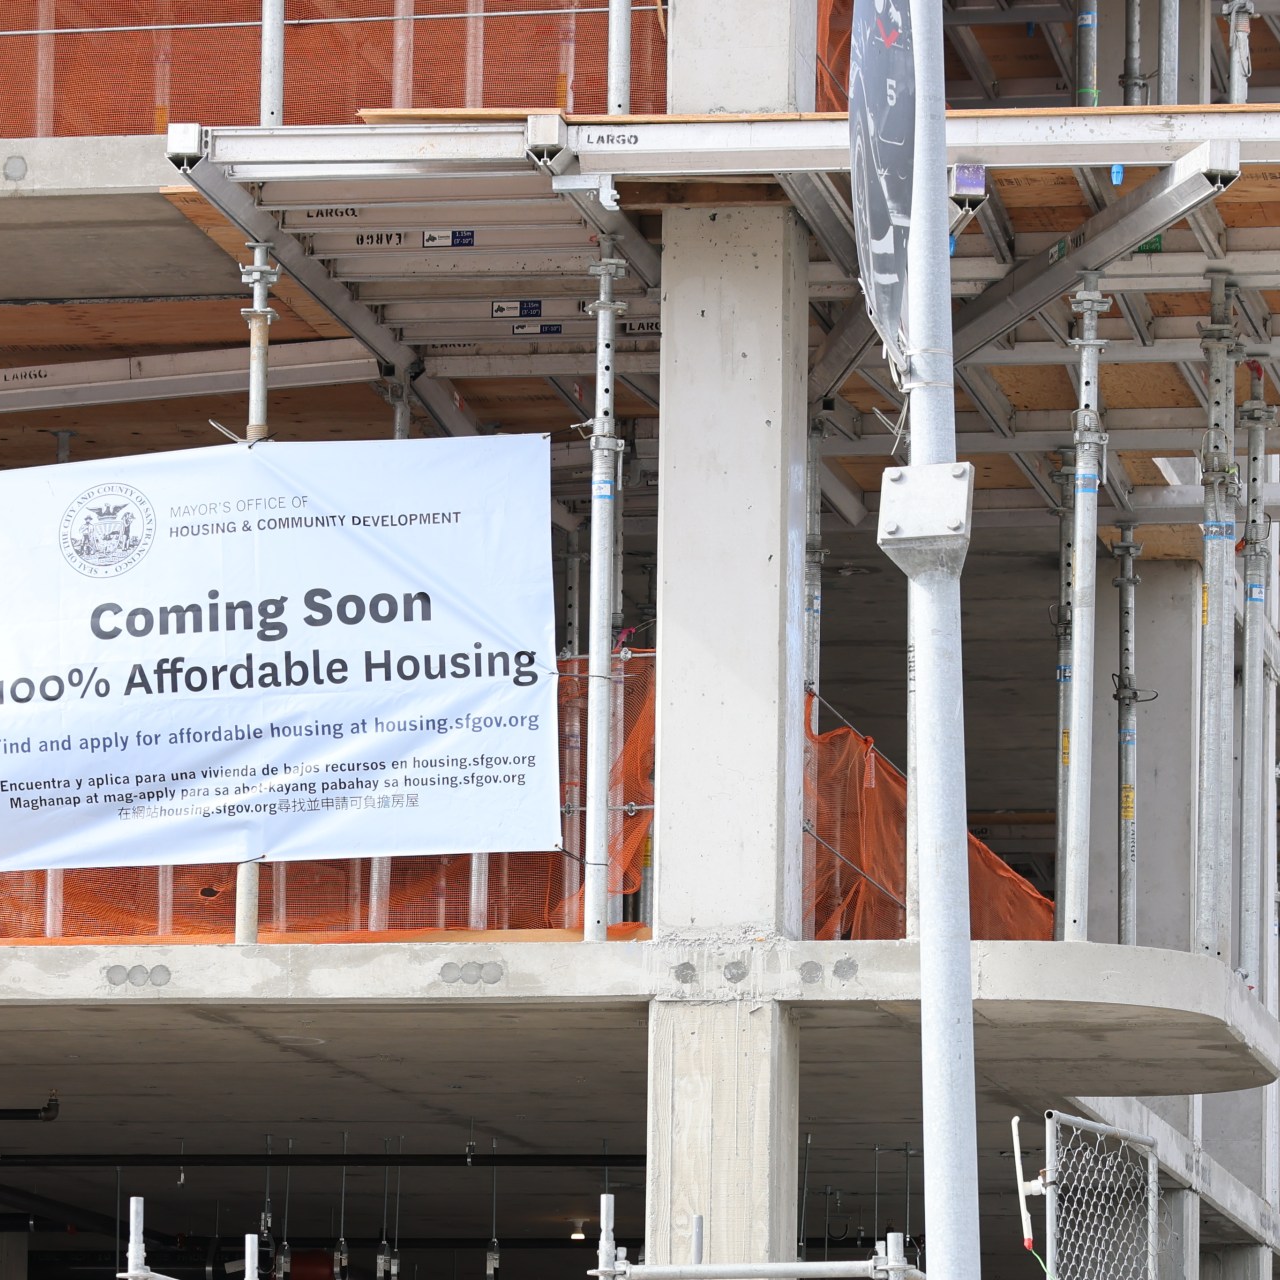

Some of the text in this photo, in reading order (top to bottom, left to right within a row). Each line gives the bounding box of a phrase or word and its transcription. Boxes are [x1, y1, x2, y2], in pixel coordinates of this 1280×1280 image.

[586, 132, 639, 146] LARGO
[306, 206, 358, 219] LARGO
[3, 369, 48, 382] LARGO
[76, 490, 96, 508] AND
[96, 485, 137, 498] COUNTY
[62, 506, 76, 530] CITY
[142, 506, 154, 526] SAN
[169, 495, 309, 519] MAYOR'S OFFICE OF
[169, 511, 462, 538] HOUSING & COMMUNITY DEVELOPMENT
[61, 534, 71, 552] THE
[77, 561, 99, 575] SEAL
[89, 587, 433, 642] Coming Soon
[123, 648, 349, 697] Affordable
[363, 641, 540, 688] Housing
[38, 734, 72, 754] and
[78, 731, 130, 754] apply
[135, 729, 162, 748] for
[168, 723, 265, 746] affordable
[269, 719, 345, 740] housing
[349, 717, 368, 735] at
[373, 712, 541, 736] housing.sfgov.org
[0, 752, 537, 794] Encuentra y aplica para una vivienda de bajos recursos en housing.sfgov.org
[9, 771, 527, 812] Maghanap at mag-apply para sa abot-kayang pabahay sa housing.sfgov.org
